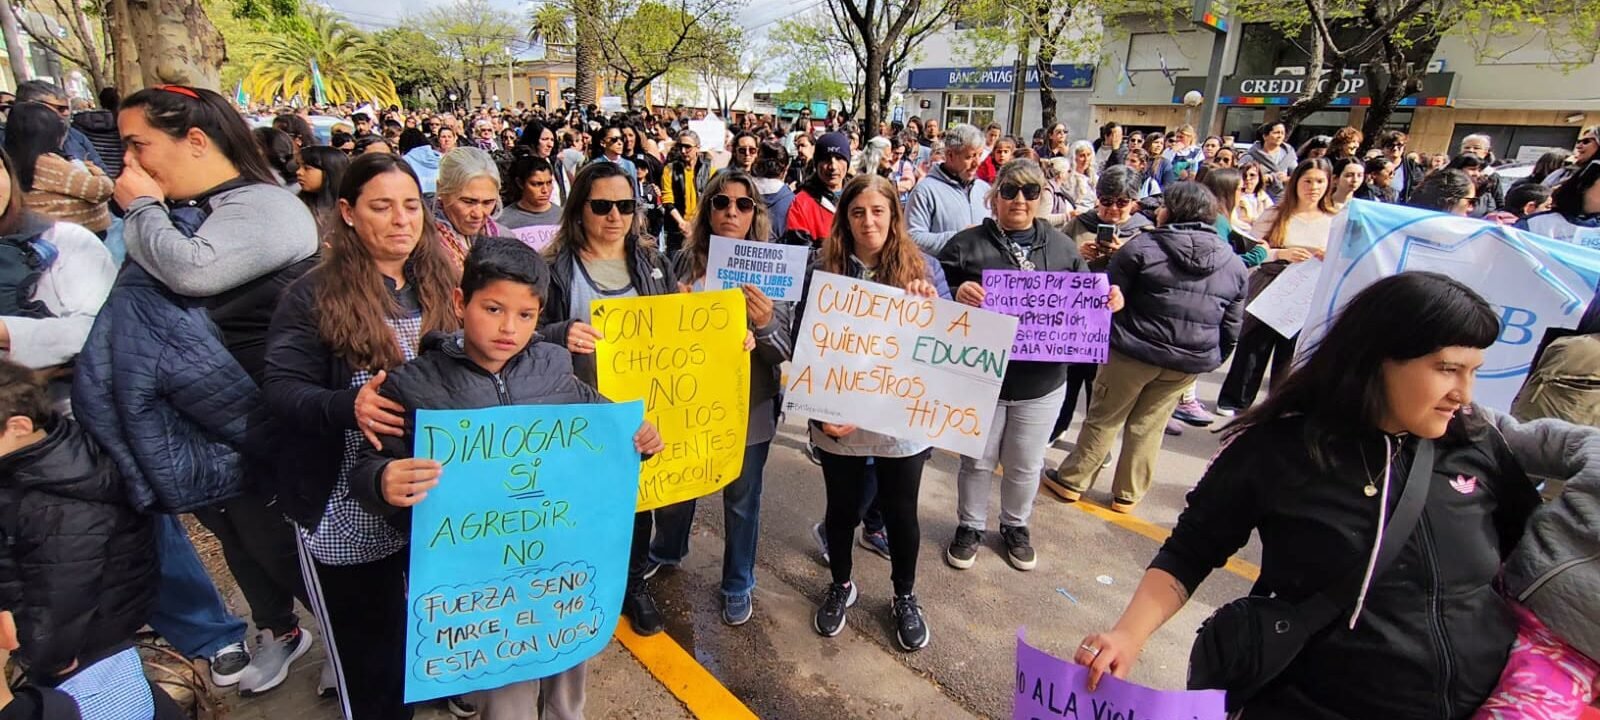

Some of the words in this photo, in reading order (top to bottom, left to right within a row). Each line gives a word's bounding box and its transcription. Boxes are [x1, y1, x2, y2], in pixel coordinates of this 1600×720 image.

[1240, 78, 1364, 94] CREDIOOP
[727, 256, 773, 273] APRENDER
[776, 263, 787, 273] EN
[734, 244, 783, 260] QUEREMOS
[717, 268, 761, 285] ESCUELAS
[764, 275, 793, 287] LIBRES
[678, 302, 729, 332] LOS
[947, 311, 971, 337] A
[913, 336, 1006, 378] EDUCAN
[647, 373, 697, 412] NO
[790, 365, 812, 394] A
[825, 365, 926, 399] NUESTROS
[685, 401, 727, 429] LOS
[640, 428, 737, 472] OCENTES
[504, 539, 544, 565] NO
[424, 586, 516, 622] FUERZA
[436, 619, 508, 650] MARCE,
[516, 609, 541, 626] EL
[554, 595, 585, 619] 916
[425, 649, 488, 676] ESTA
[496, 635, 538, 660] CON
